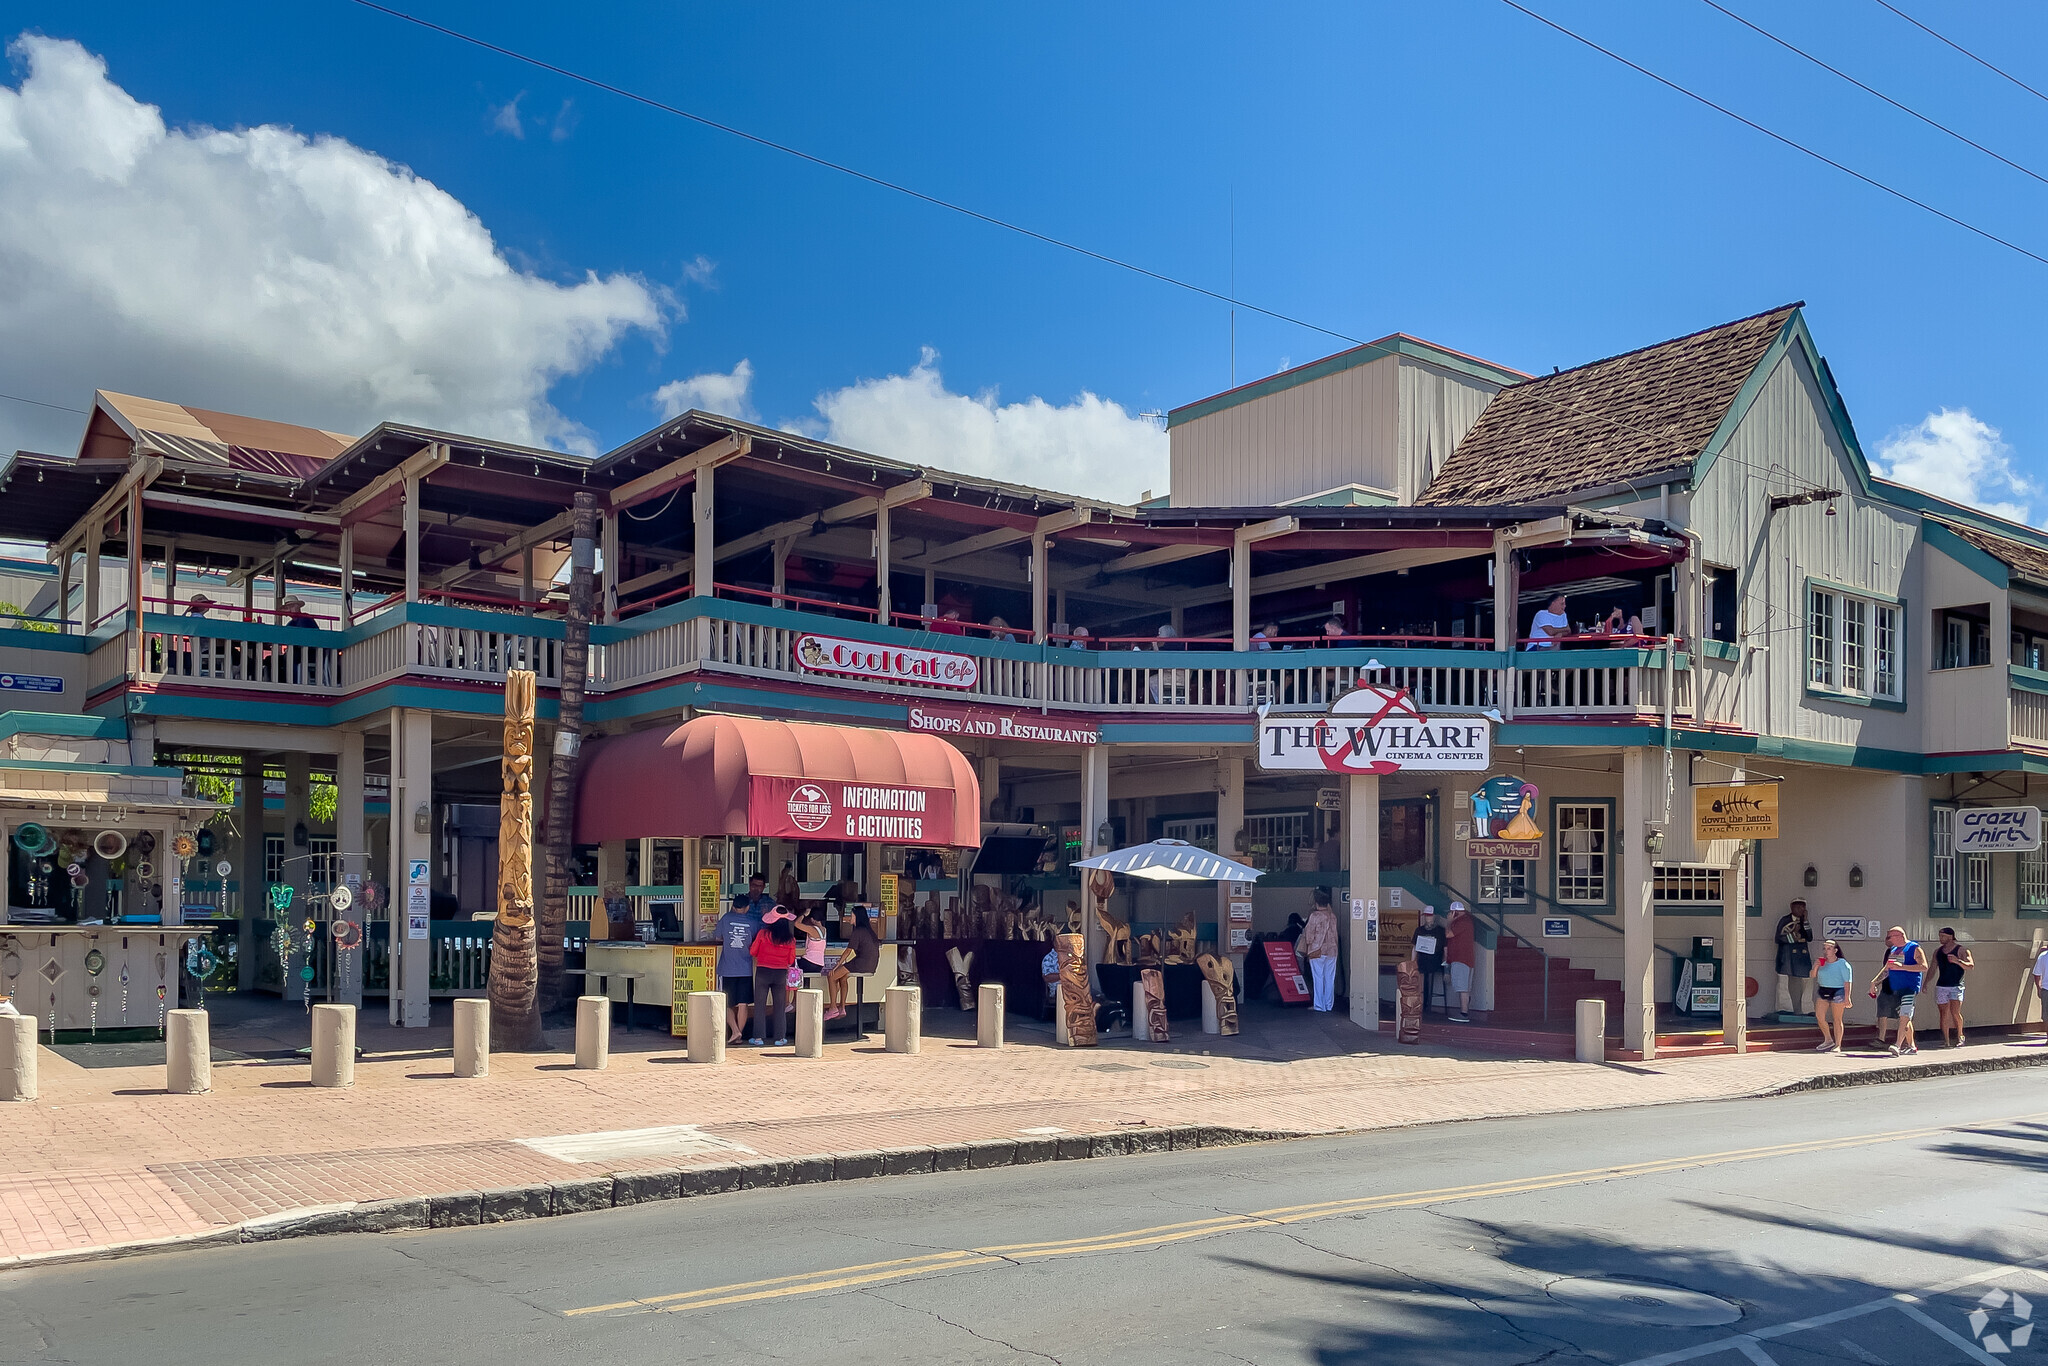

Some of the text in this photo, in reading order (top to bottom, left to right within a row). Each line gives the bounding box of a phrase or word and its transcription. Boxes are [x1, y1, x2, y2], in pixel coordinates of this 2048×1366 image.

[833, 644, 891, 673] Cool
[895, 652, 940, 679] Cat
[910, 708, 1097, 744] SHOPS AND RESTAURANTS
[1265, 726, 1485, 757] THE WHARF
[1385, 752, 1484, 760] CINEMA CENTER
[843, 786, 926, 812] INFORMATION
[787, 803, 832, 815] TICKETS FOR LESS
[1701, 814, 1771, 824] down the hatch
[1963, 811, 2028, 827] crazy
[846, 814, 922, 839] & ACTIVITIES
[1470, 842, 1538, 857] The Wharf
[1828, 919, 1861, 928] crazy
[675, 956, 702, 967] HELICOPTER
[675, 968, 714, 979] LUAU 45
[675, 980, 694, 990] ZIPLINE
